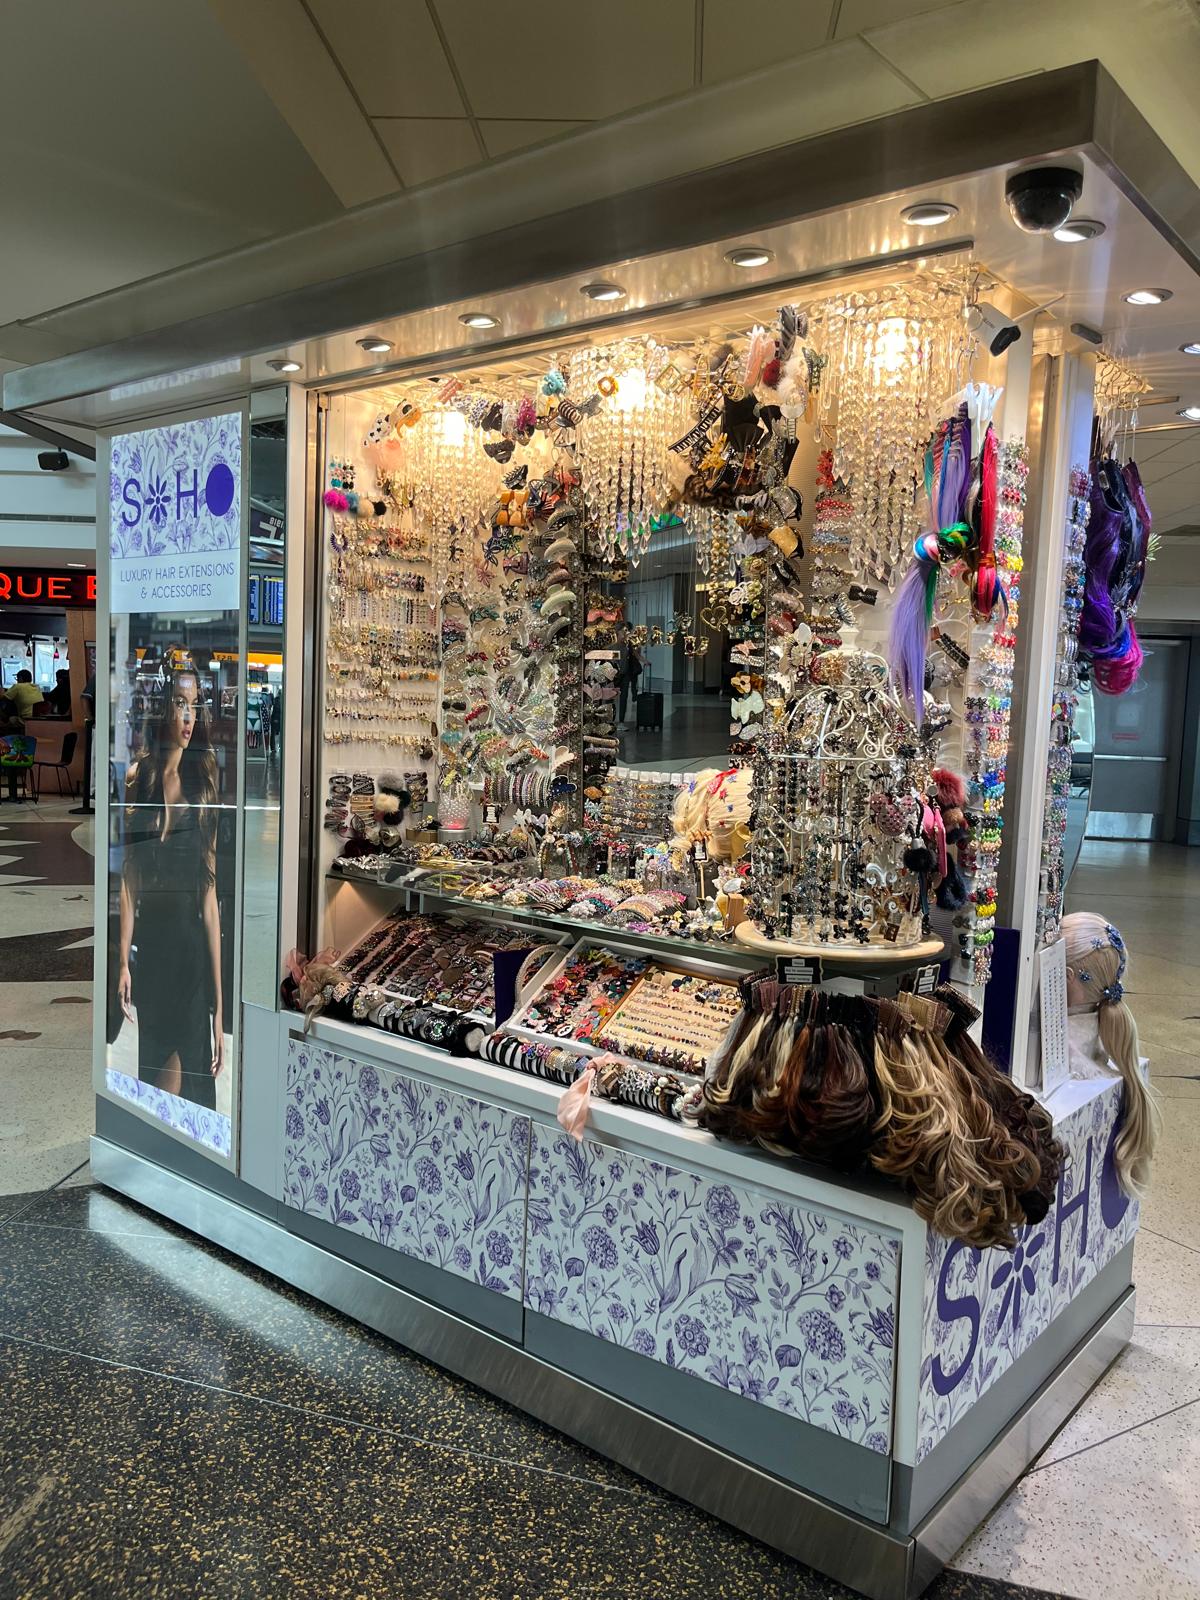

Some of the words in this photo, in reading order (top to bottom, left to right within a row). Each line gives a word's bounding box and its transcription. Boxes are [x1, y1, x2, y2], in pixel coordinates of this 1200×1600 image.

[120, 568, 152, 582] LUXURY
[155, 566, 175, 580] HAIR
[179, 562, 234, 579] EXTENSIONS
[140, 586, 147, 599] &
[152, 583, 211, 598] ACCESSORIES
